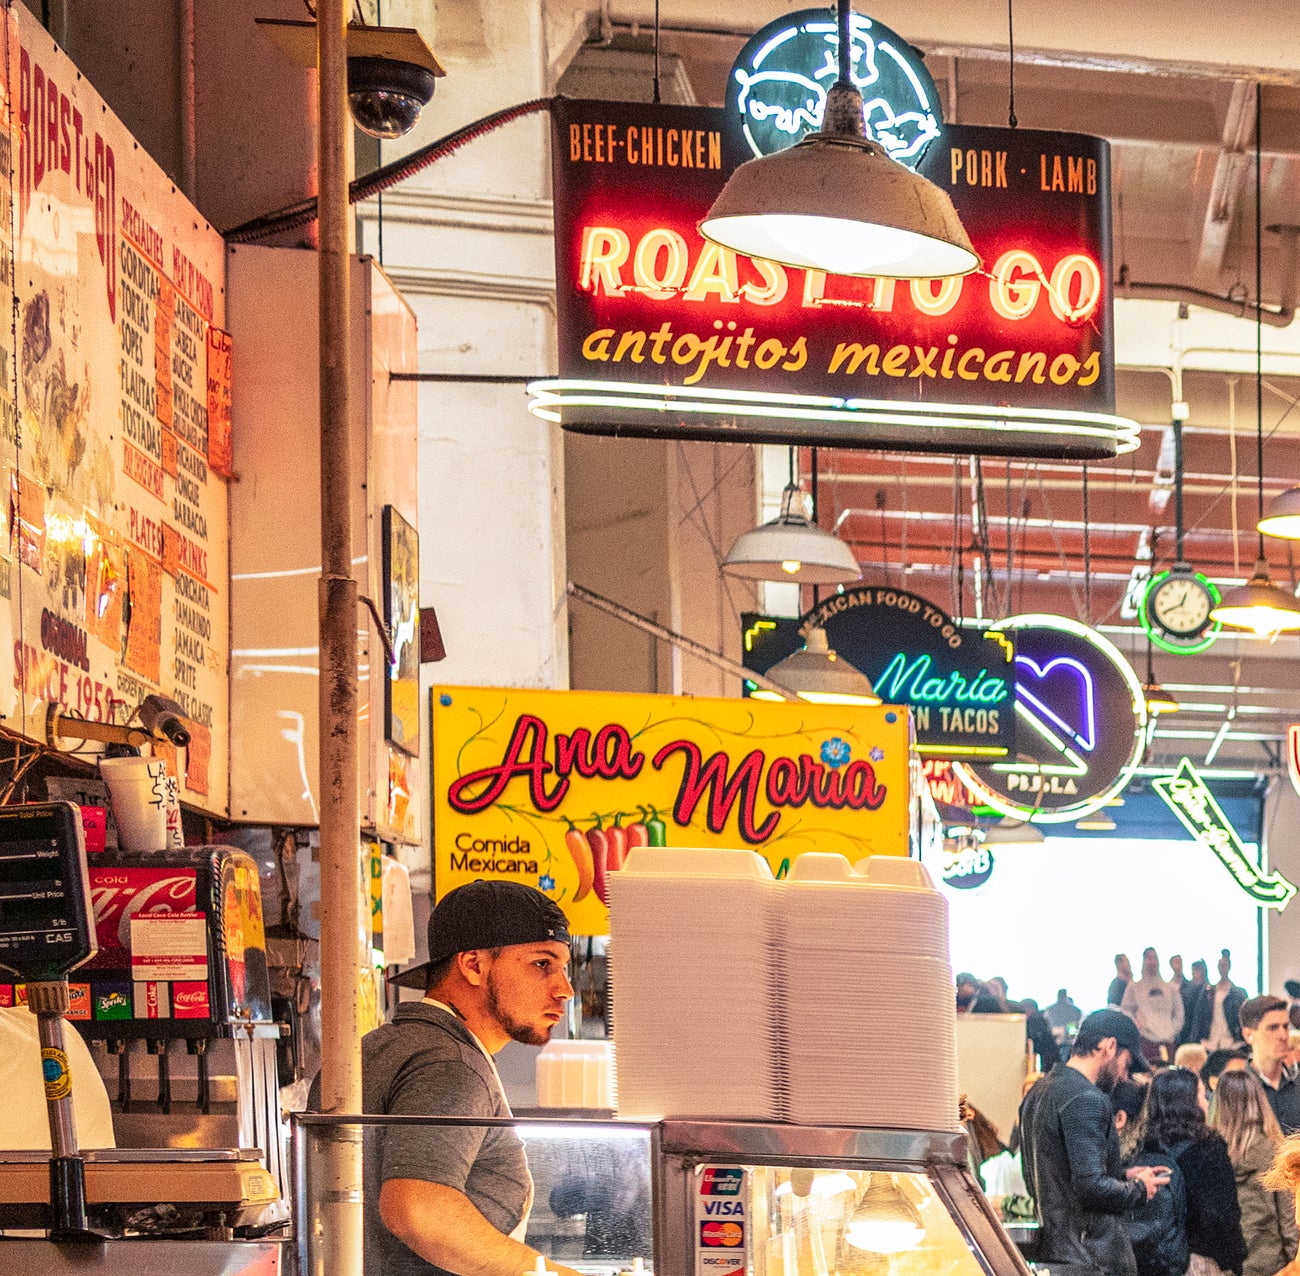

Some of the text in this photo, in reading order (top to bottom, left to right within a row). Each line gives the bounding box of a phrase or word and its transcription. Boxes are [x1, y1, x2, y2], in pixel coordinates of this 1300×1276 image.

[19, 45, 83, 240] ROAST
[95, 132, 116, 325] GO
[950, 147, 1097, 196] PORK LAMB
[121, 279, 149, 334] TORTAS
[989, 249, 1102, 323] GO
[121, 318, 143, 367] SOPES
[582, 320, 1102, 387] antojitos mexicanos
[121, 359, 155, 418] FLAUTAS
[121, 399, 161, 460] TOSTADAS
[130, 507, 163, 557] PLATES
[177, 531, 208, 580] DRINKS
[875, 587, 922, 616] FOOD
[922, 603, 946, 629] TO
[940, 623, 963, 650] GO
[175, 627, 205, 667] JAMAICA
[174, 656, 196, 690] SPRITE
[873, 652, 1008, 703] Maria
[939, 707, 1000, 735] TACOS
[447, 713, 646, 815] Ana
[652, 738, 888, 845] Maria
[450, 852, 539, 876] Mexicana
[455, 832, 531, 854] Comida
[45, 933, 73, 944] CAS
[704, 1201, 745, 1217] VISA
